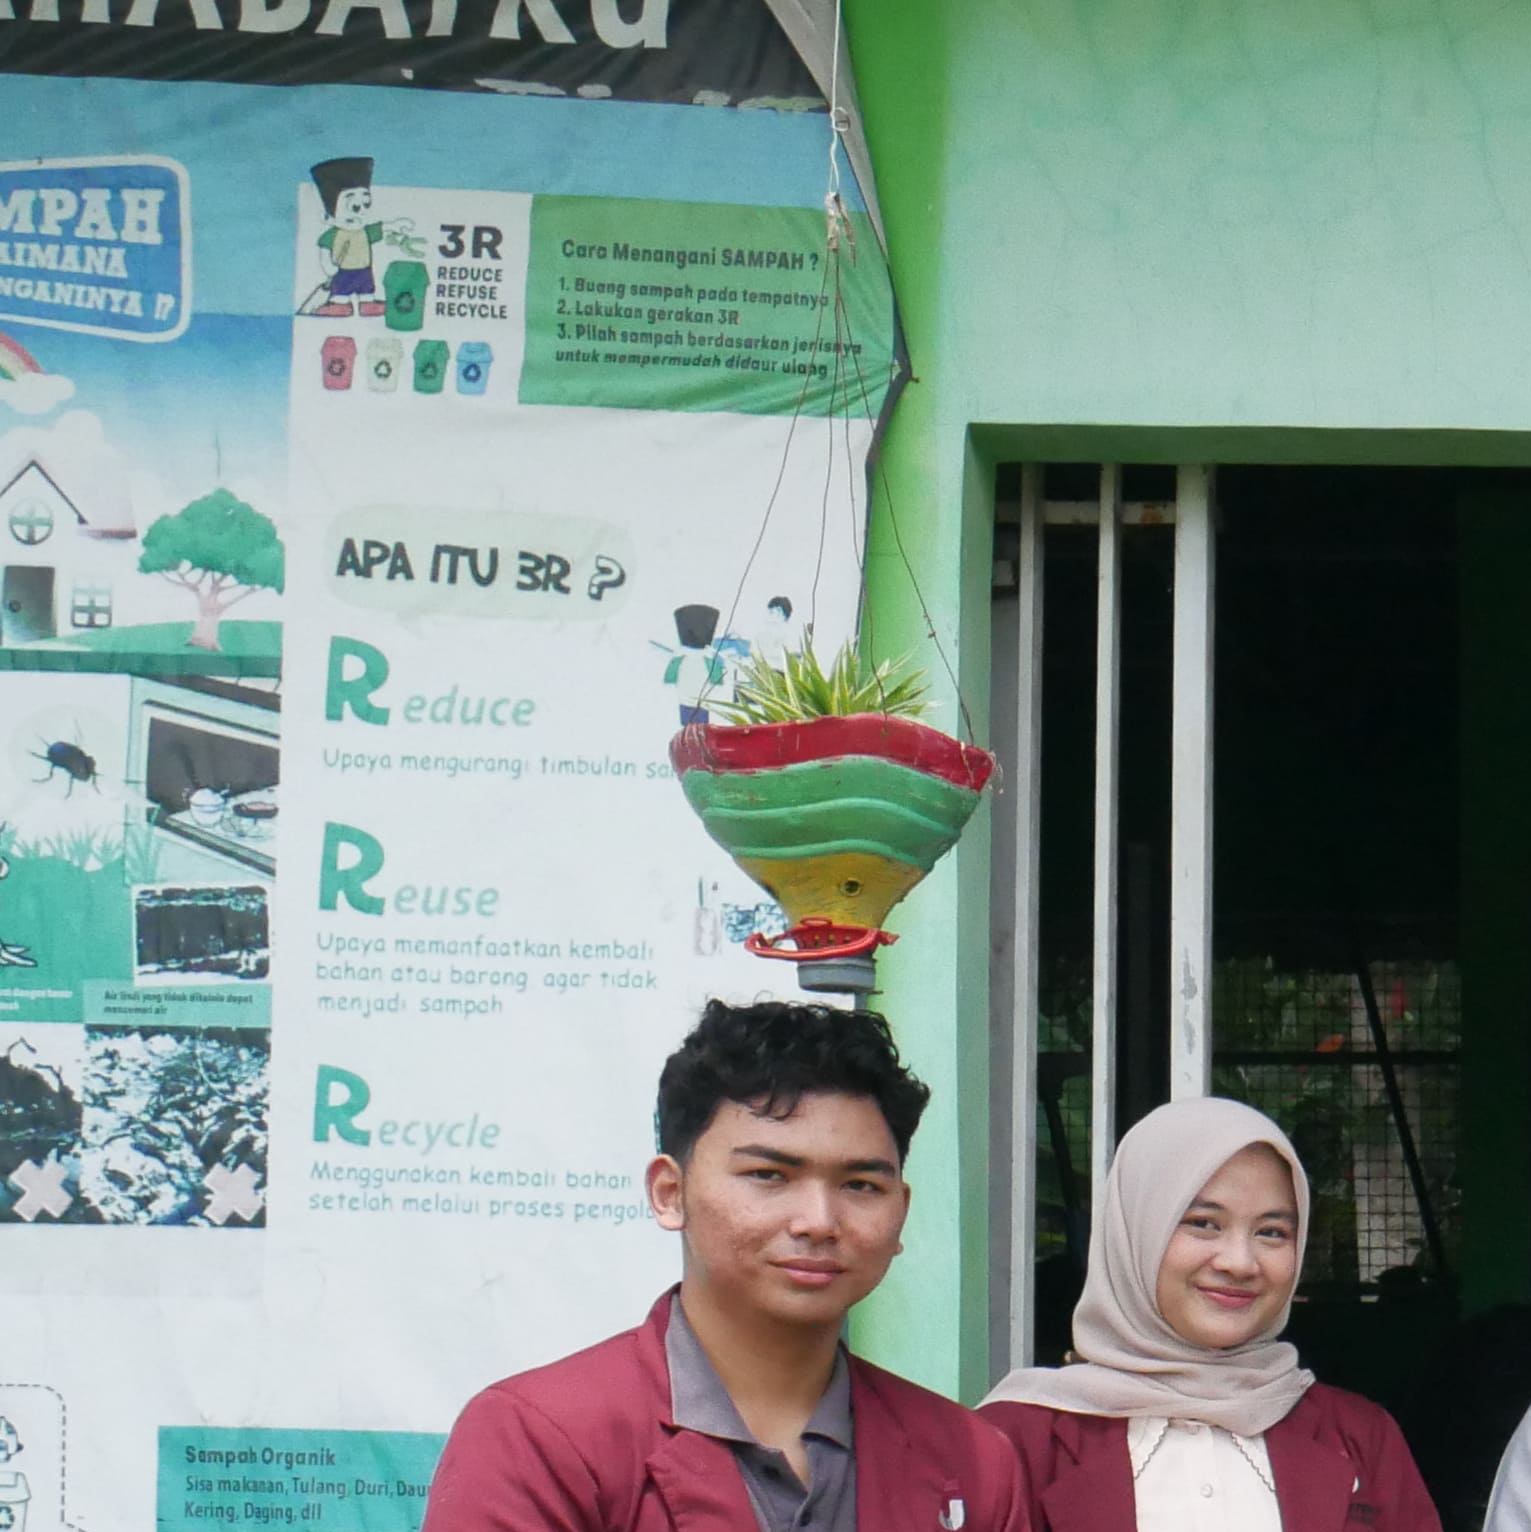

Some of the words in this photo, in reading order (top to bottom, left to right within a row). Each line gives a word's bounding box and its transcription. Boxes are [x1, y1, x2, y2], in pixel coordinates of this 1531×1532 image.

[438, 224, 503, 260] 3R
[562, 239, 607, 260] Cara
[612, 242, 716, 270] Menangani
[721, 248, 804, 271] SAMPAH
[437, 266, 503, 283] REDUCE
[436, 283, 498, 300] REFUSE
[574, 277, 626, 300] Buang
[629, 284, 693, 303] sampah
[696, 287, 738, 305] pada
[742, 288, 829, 311] tempatnya
[436, 301, 508, 320] RECYCLE
[556, 300, 571, 316] 2.
[574, 300, 643, 320] Lakukan
[647, 307, 714, 325] gerakan
[718, 309, 740, 326] 3R
[620, 329, 684, 349] sampah
[687, 331, 790, 353] berdasarkan
[555, 348, 600, 365] untuk
[725, 351, 778, 374] didaur
[782, 357, 829, 380] ulang
[335, 537, 416, 582] APA
[429, 543, 499, 588] ITU
[515, 551, 572, 595] 3R
[587, 555, 627, 602] ?
[323, 748, 393, 775] Upaya
[400, 754, 529, 781] mengurangi
[540, 755, 637, 778] timbulan
[316, 933, 387, 959] Upaya
[394, 933, 562, 960] memanfaatkan
[568, 939, 654, 962] kembali
[315, 963, 383, 983] bahan
[390, 966, 442, 984] atau
[449, 966, 529, 993] barang
[543, 972, 591, 996] agar
[600, 970, 658, 991] tidak
[317, 994, 408, 1020] menjadi
[419, 995, 505, 1022] sampah
[309, 1160, 462, 1190] Menggunakan
[469, 1162, 556, 1188] kembali
[565, 1168, 632, 1191] bahan
[308, 1191, 393, 1213] setelah
[401, 1193, 481, 1216] melalui
[489, 1198, 565, 1221] proses
[185, 1445, 257, 1468] Sampah
[260, 1447, 337, 1471] Organik
[186, 1475, 214, 1493] Sisa
[217, 1476, 289, 1497] makanan,
[354, 1479, 395, 1500] Duri,
[184, 1502, 240, 1524] Kering,
[244, 1503, 299, 1525] Daging,
[301, 1503, 323, 1521] dll
